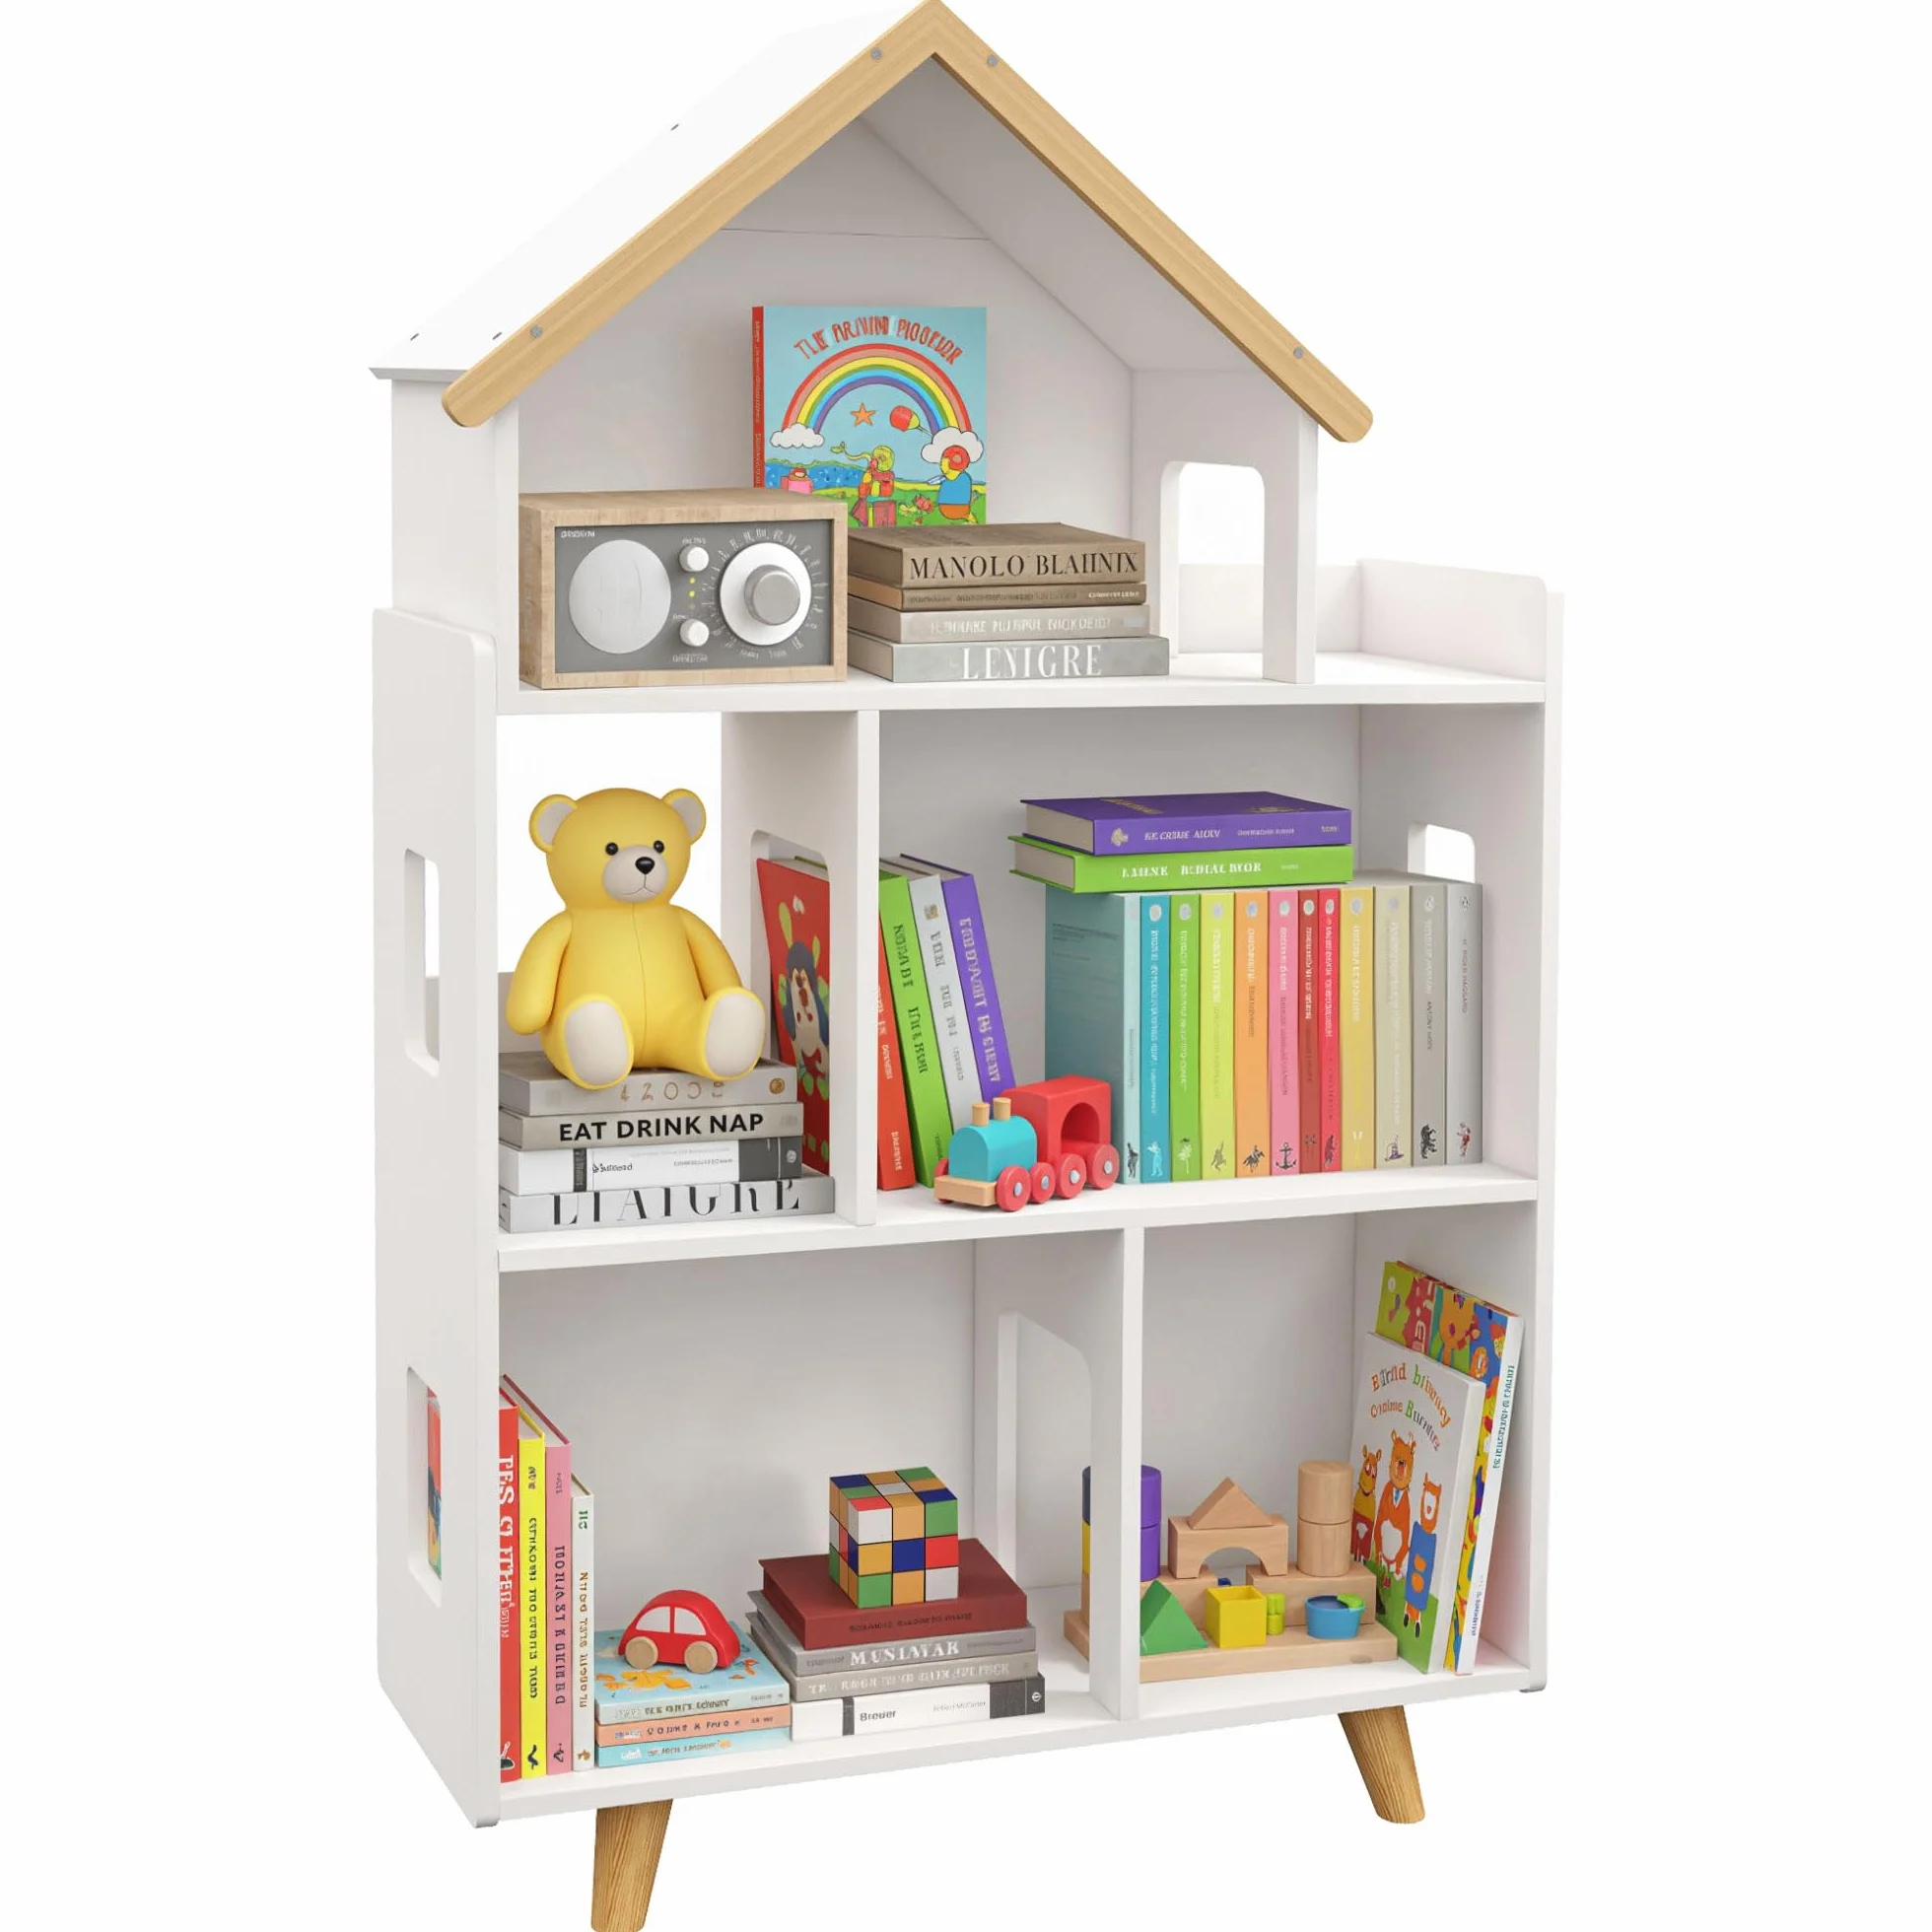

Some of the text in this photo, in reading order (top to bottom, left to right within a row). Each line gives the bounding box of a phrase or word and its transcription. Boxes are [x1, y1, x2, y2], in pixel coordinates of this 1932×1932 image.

[910, 554, 1024, 580] MANOLO
[559, 1113, 763, 1141] EAT DRINK NAP
[860, 1708, 897, 1722] Breuer
